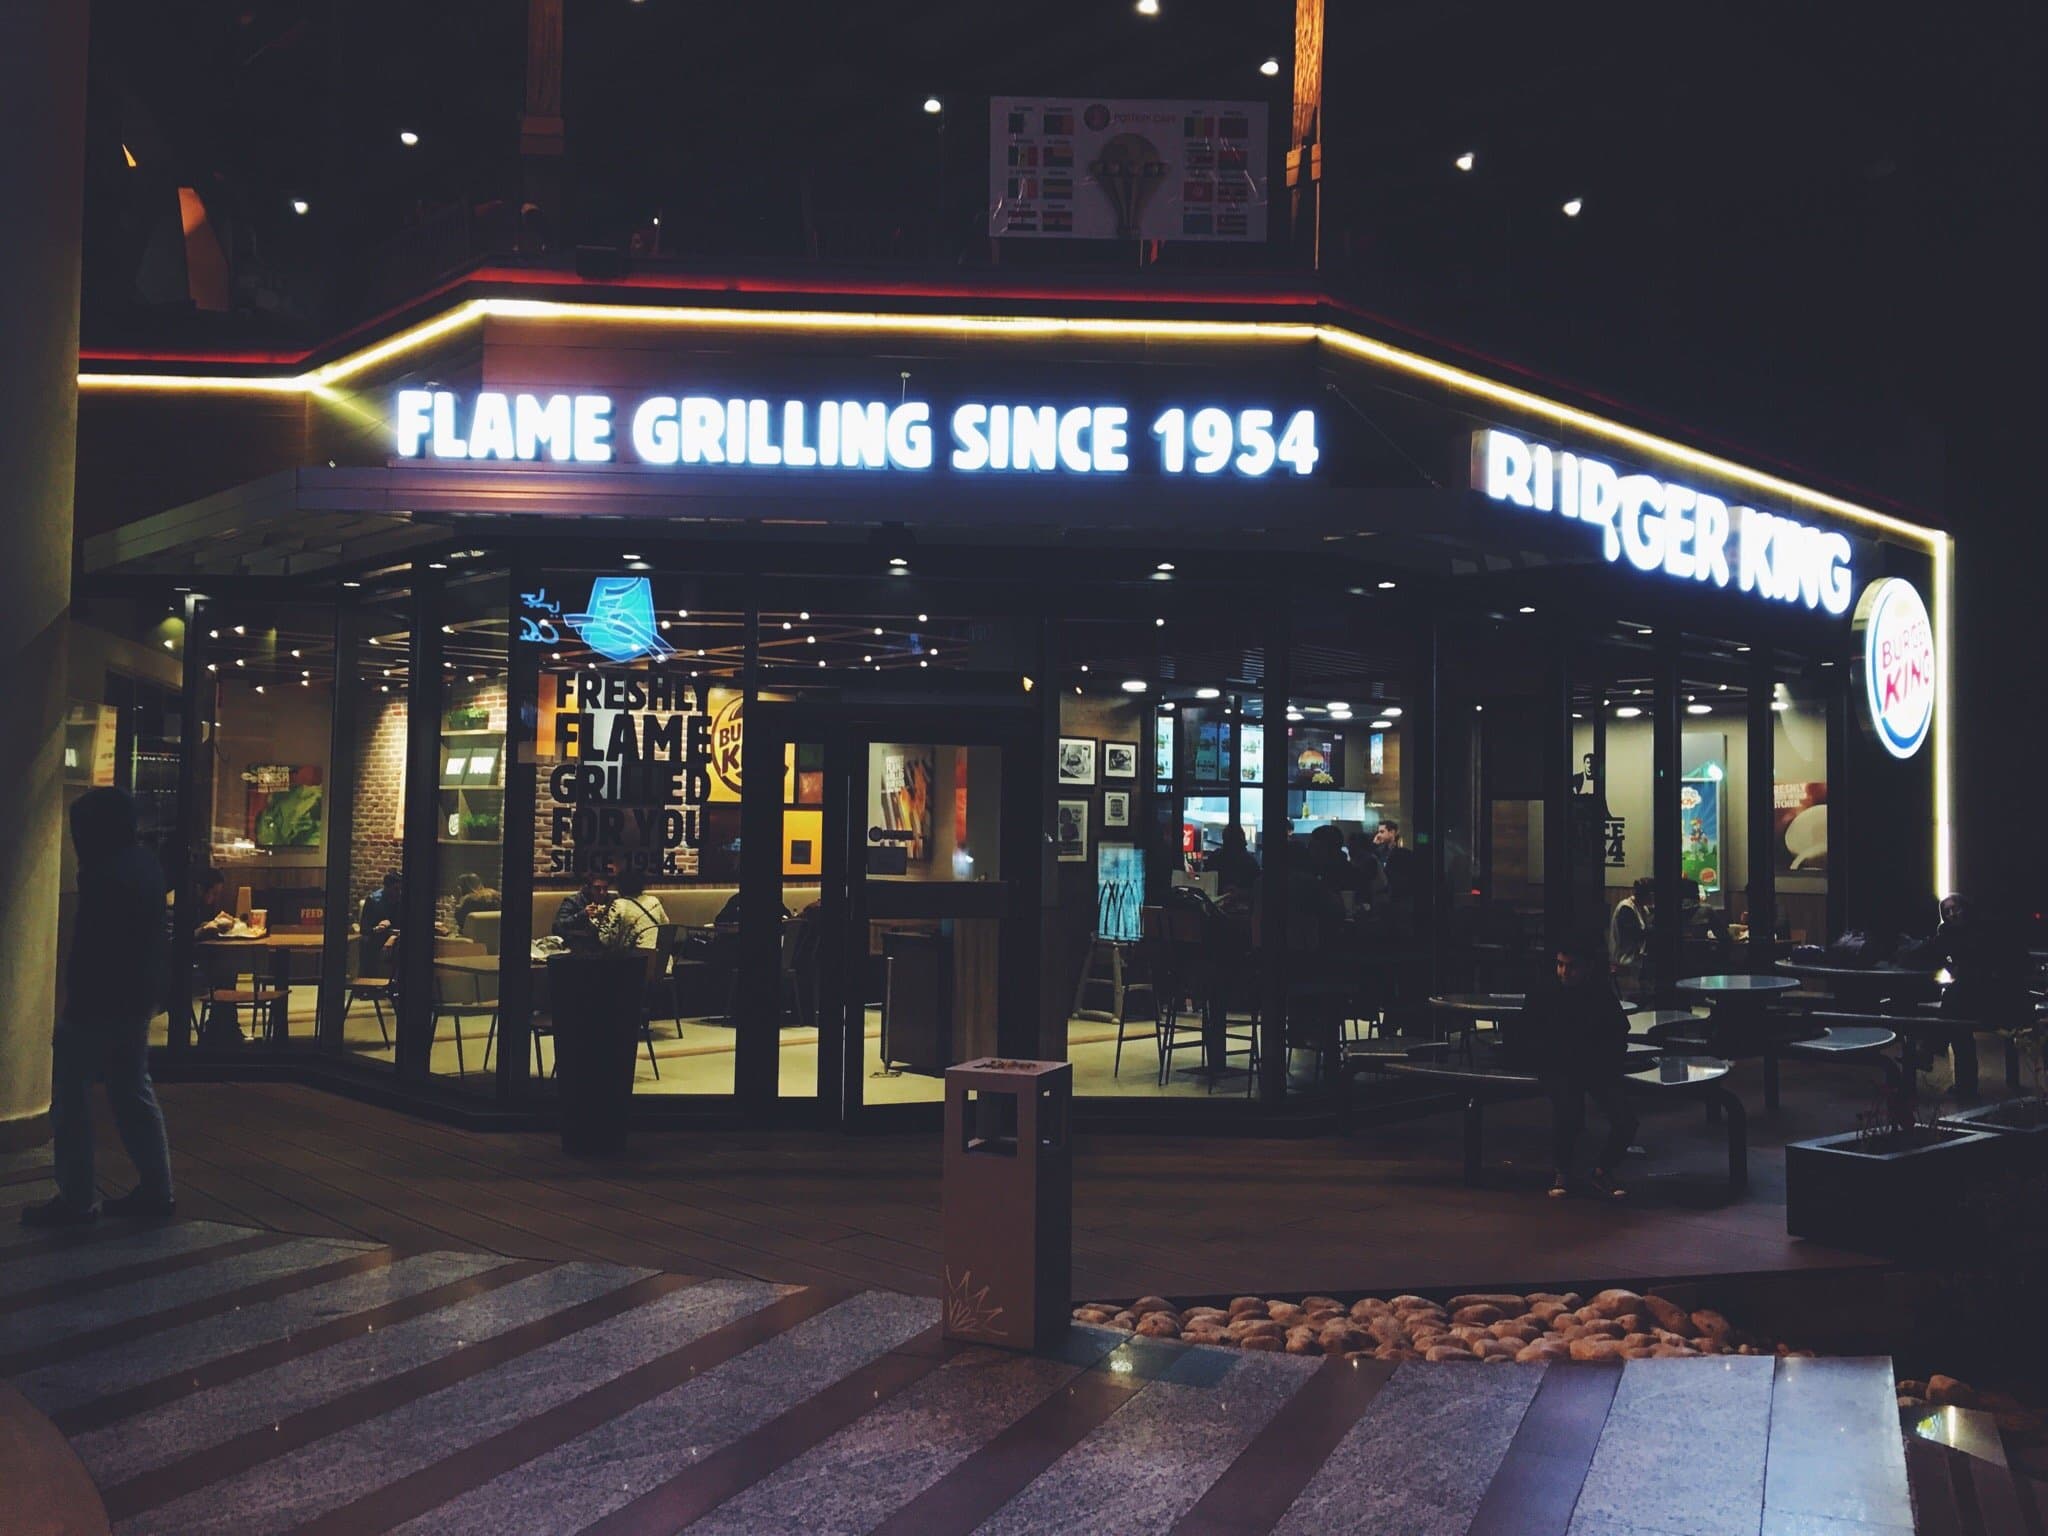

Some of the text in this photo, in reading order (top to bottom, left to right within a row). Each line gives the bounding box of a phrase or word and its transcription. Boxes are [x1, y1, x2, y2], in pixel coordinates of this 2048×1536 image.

[398, 390, 1319, 476] FLAME GRILLING SINCE 1954
[1738, 505, 1852, 615] KING
[557, 672, 709, 711] FRESHLY
[556, 712, 712, 764] FLAME
[550, 764, 711, 805] GRIED
[552, 807, 706, 849] FOR YOU
[551, 851, 612, 873] SICE
